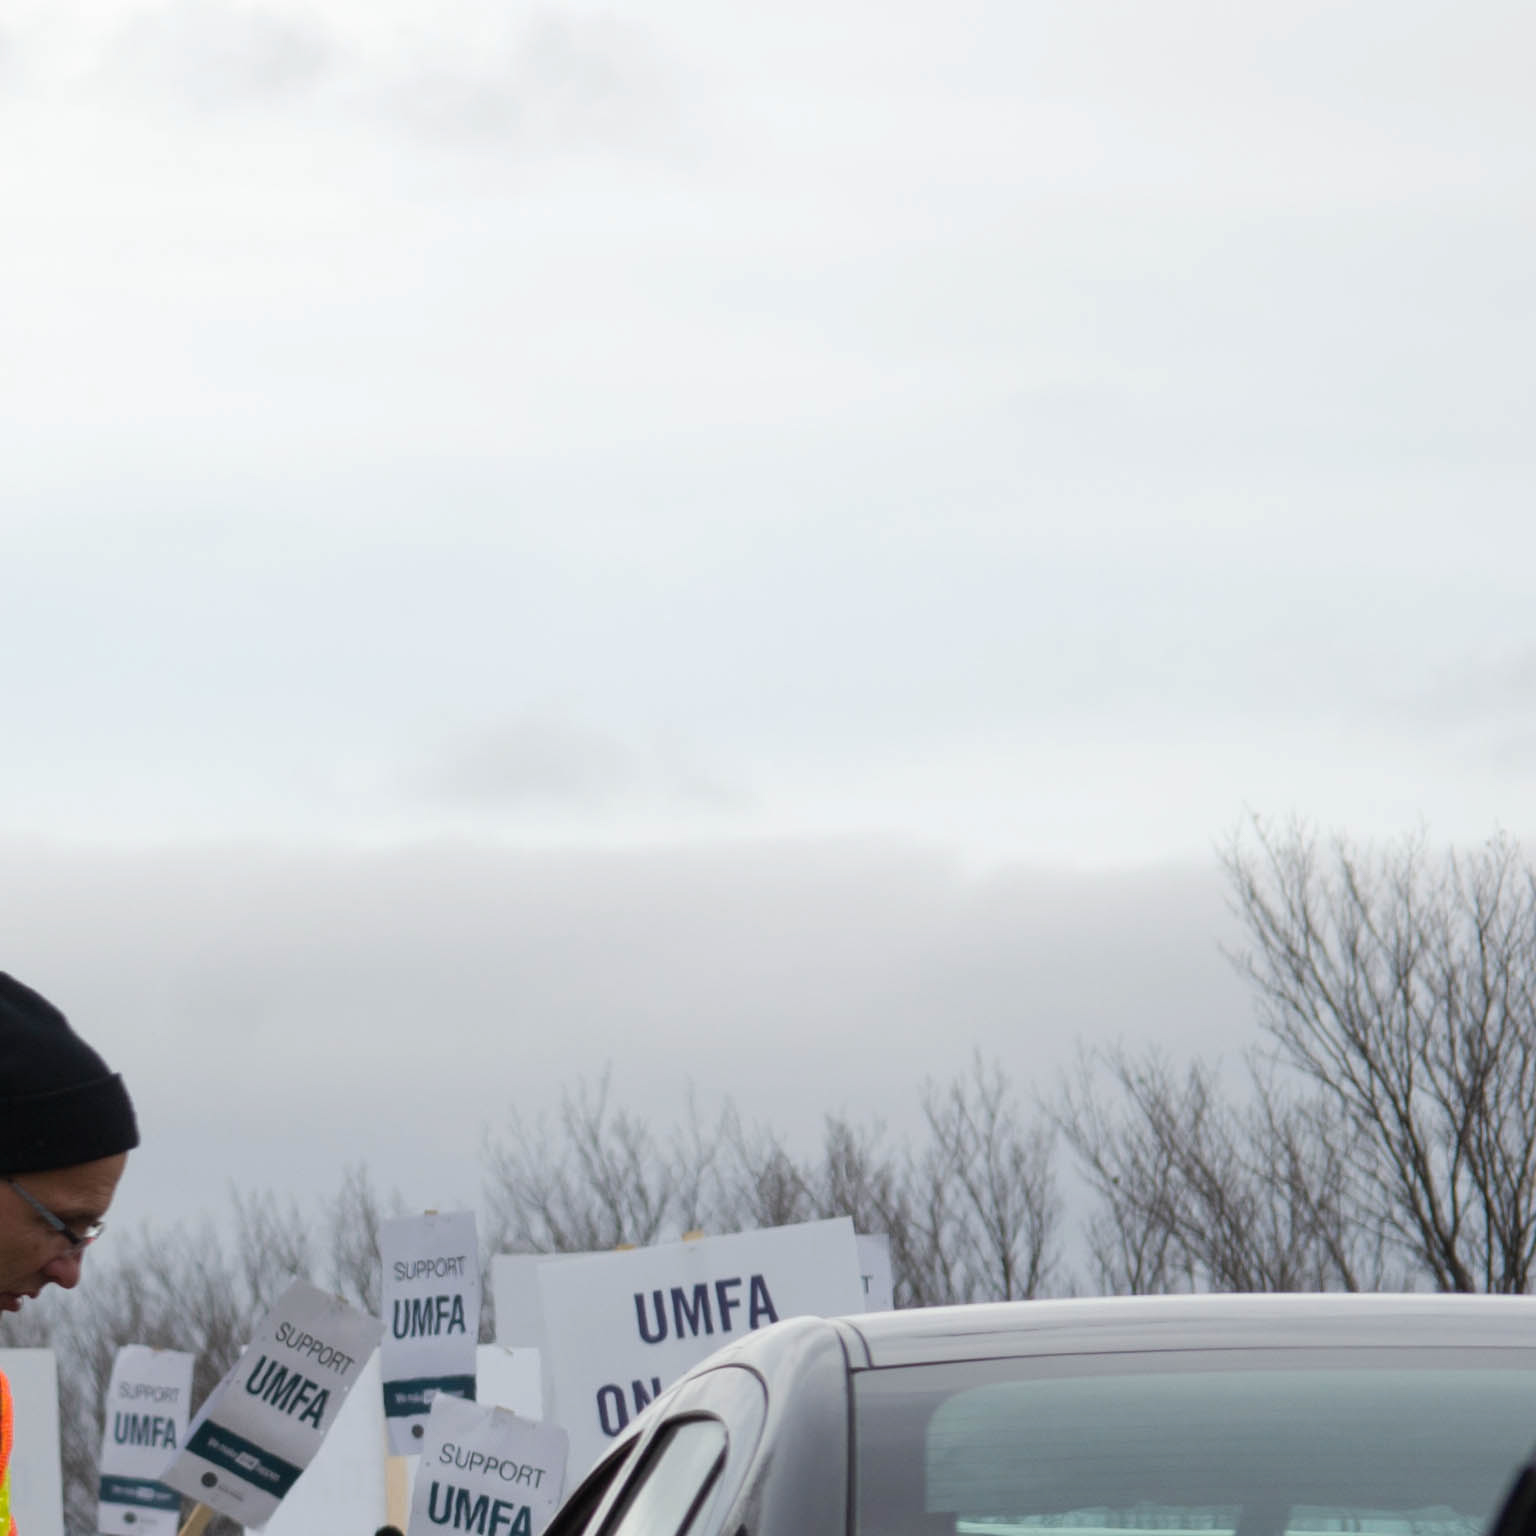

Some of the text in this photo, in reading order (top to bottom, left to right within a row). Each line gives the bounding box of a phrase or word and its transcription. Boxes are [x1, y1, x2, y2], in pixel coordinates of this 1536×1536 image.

[393, 1255, 468, 1283] SUPPORT
[392, 1293, 468, 1339] UMFA
[633, 1273, 781, 1345] UMFA
[274, 1321, 356, 1376] SUPPORT
[119, 1381, 180, 1403] SUPPORT
[244, 1354, 332, 1430] UMFA
[114, 1411, 177, 1449] UMFA
[438, 1442, 547, 1490] SUPPORT
